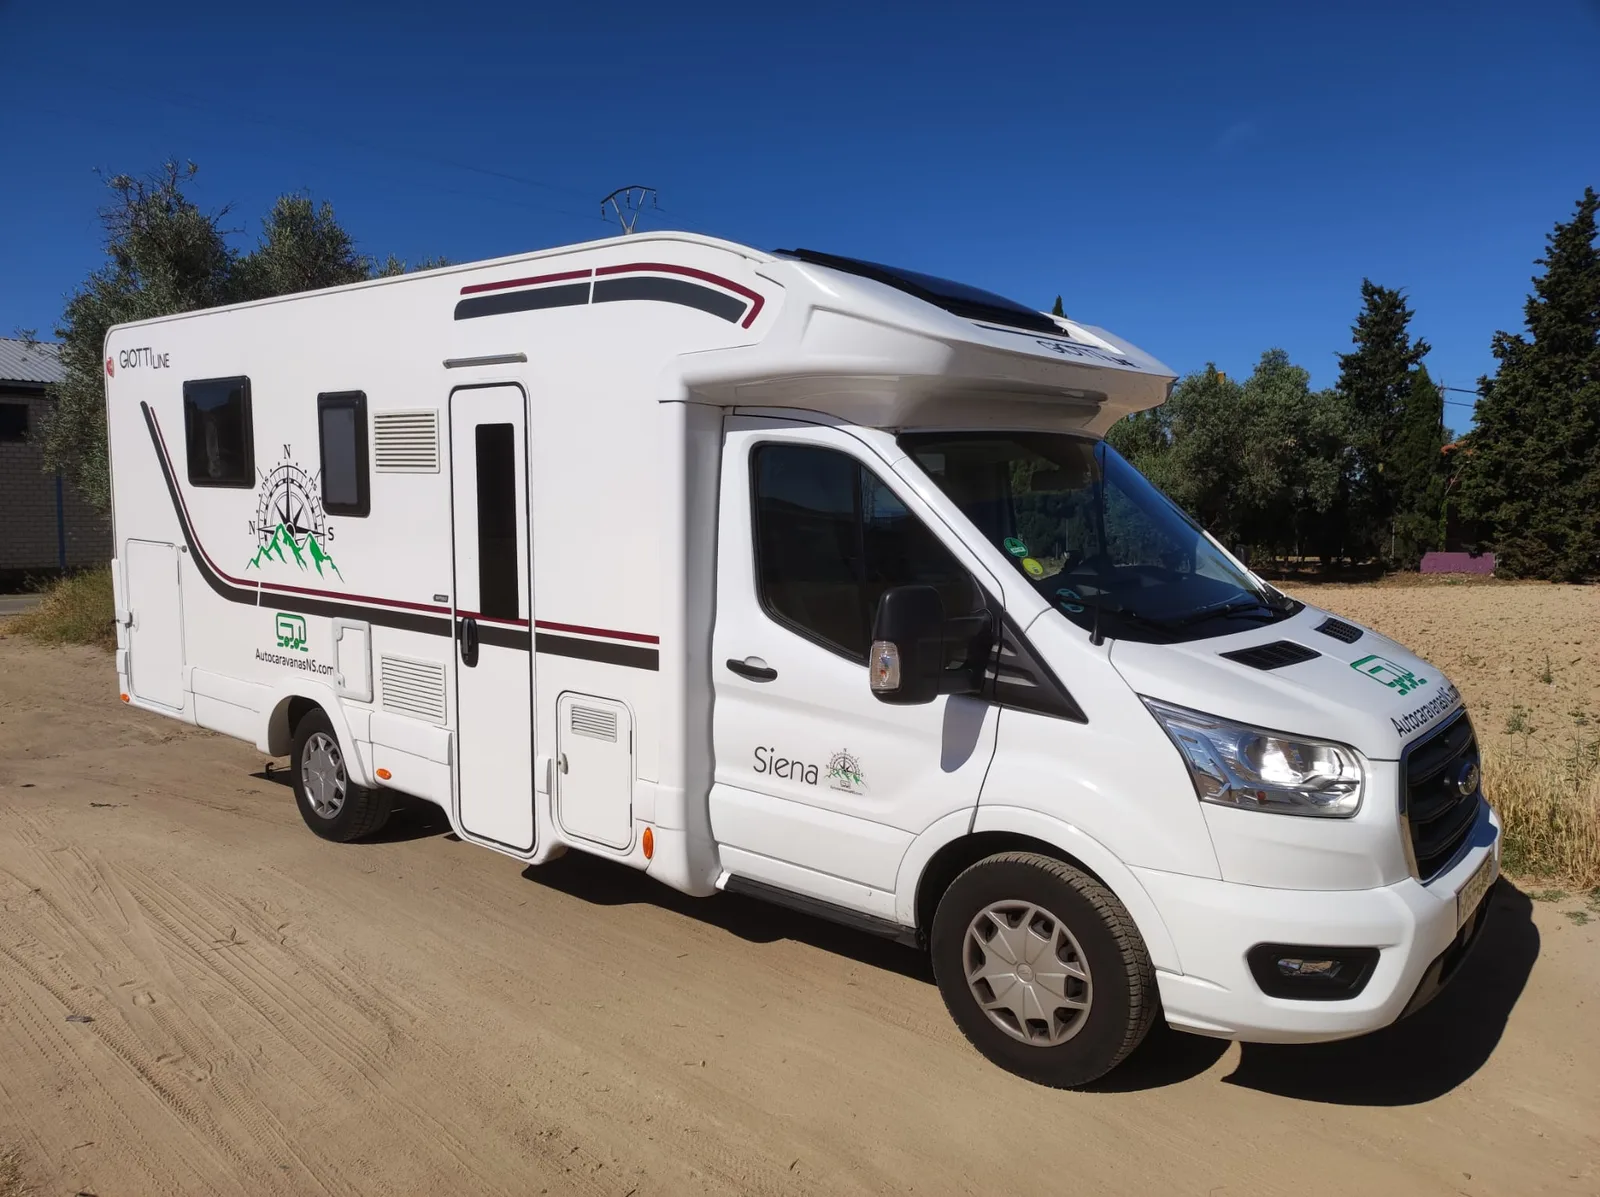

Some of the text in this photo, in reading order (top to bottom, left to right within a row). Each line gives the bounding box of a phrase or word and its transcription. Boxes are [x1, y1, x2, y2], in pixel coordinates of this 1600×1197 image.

[283, 444, 291, 459] N
[248, 520, 256, 535] N
[327, 526, 335, 541] S
[255, 648, 334, 675] AutocaravanasNS.com
[753, 746, 819, 786] Siena
